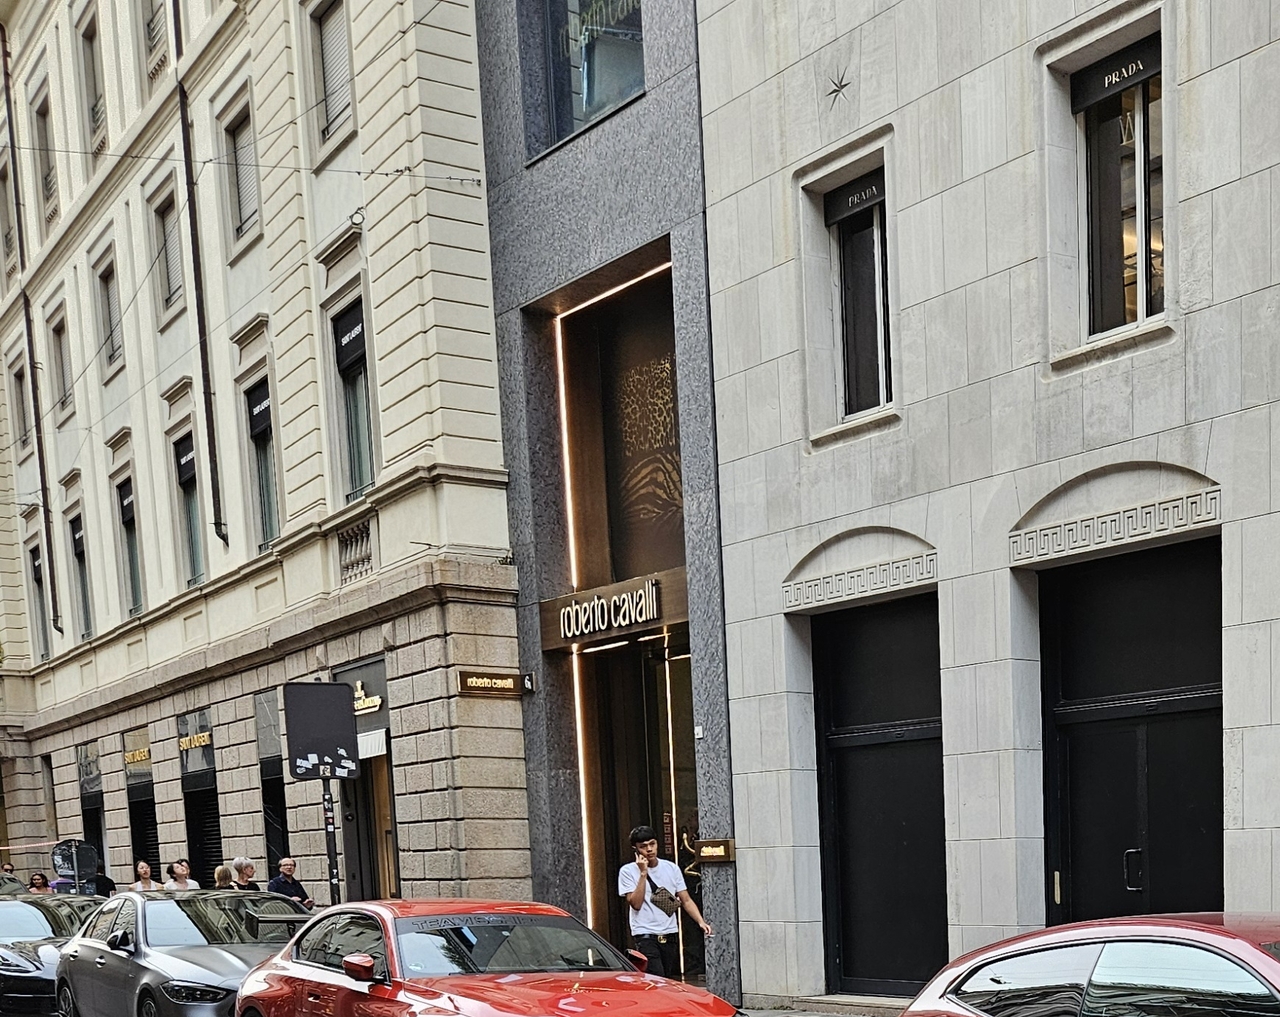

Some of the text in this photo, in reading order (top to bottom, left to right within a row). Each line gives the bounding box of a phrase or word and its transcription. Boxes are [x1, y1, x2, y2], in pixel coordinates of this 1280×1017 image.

[1104, 60, 1144, 88] PRADA
[849, 185, 878, 207] PRADA
[560, 578, 659, 639] roberto cavalli
[467, 676, 514, 689] roberto cavalli
